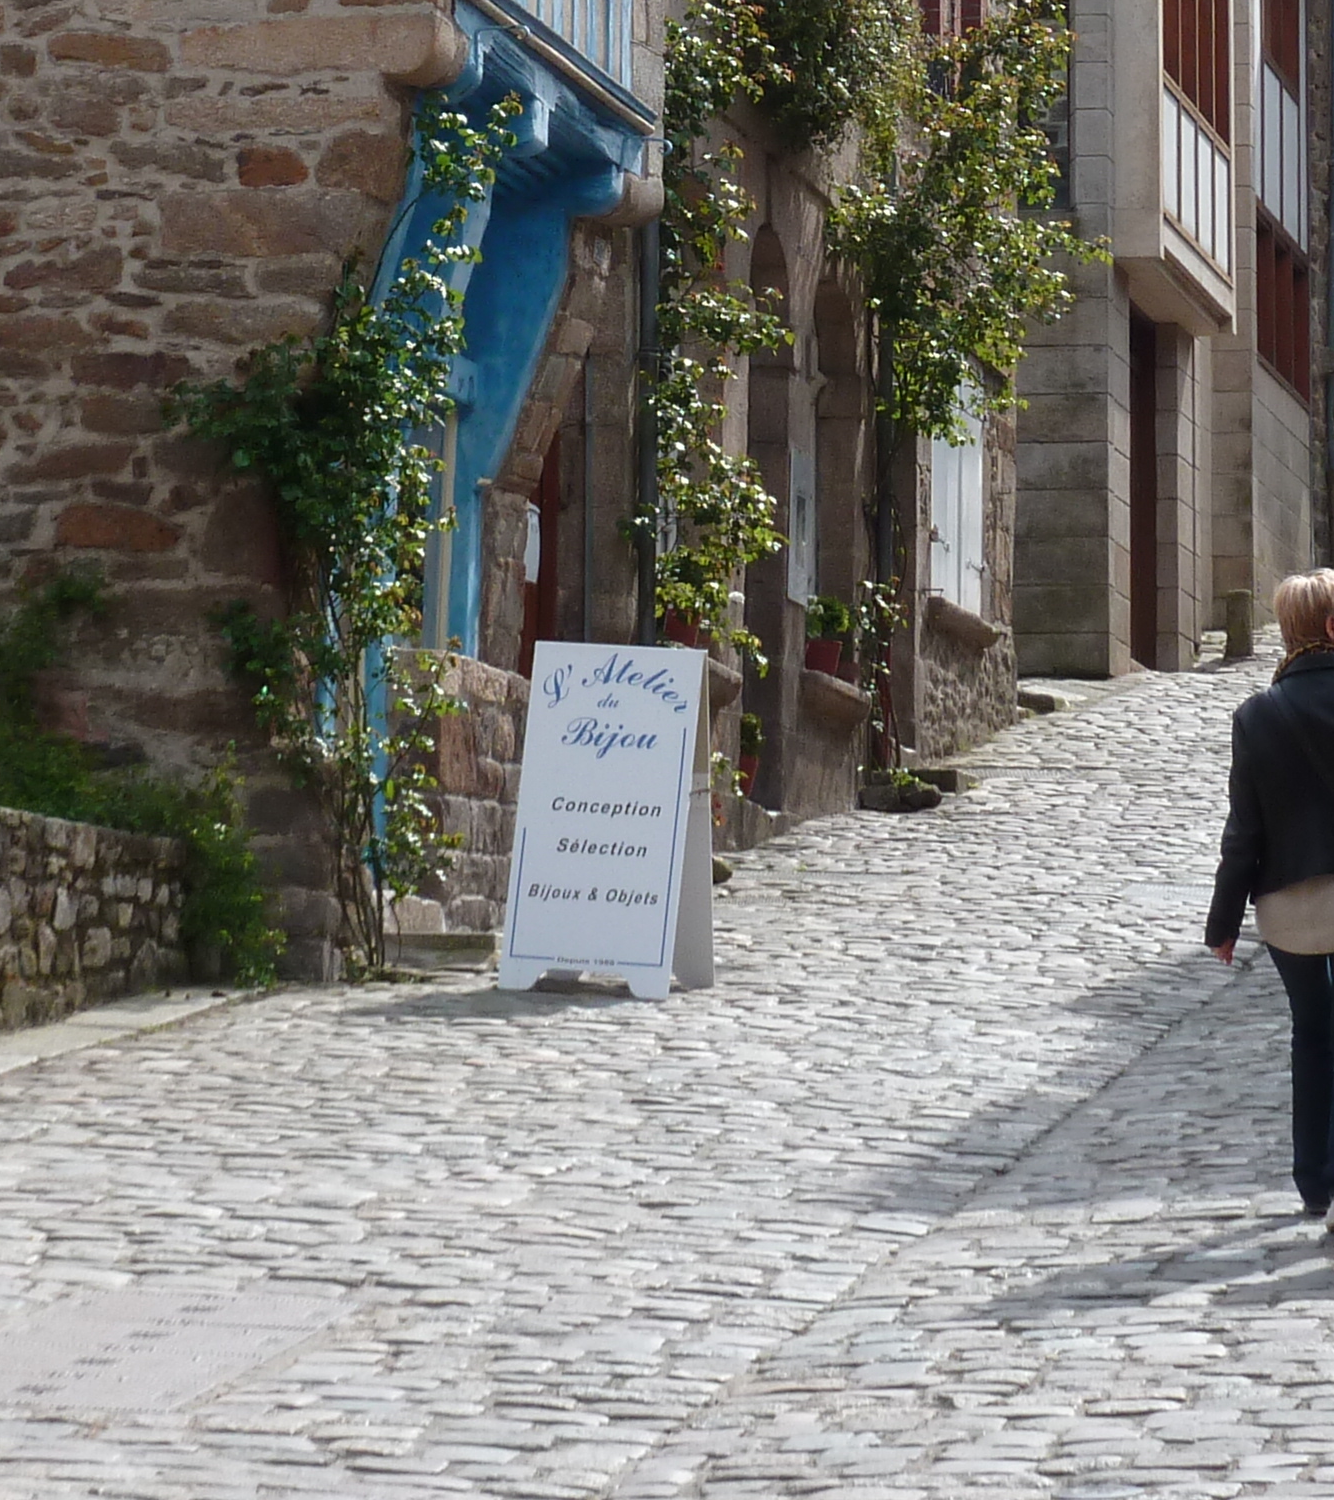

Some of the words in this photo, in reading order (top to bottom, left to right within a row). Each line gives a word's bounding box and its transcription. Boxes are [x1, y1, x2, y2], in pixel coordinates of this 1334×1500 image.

[597, 693, 620, 709] du
[561, 716, 658, 759] Bijou
[551, 796, 662, 819] Conception
[556, 837, 648, 859] Sélection
[527, 883, 582, 902] Bijoux
[587, 886, 598, 902] &
[605, 888, 659, 908] Objets
